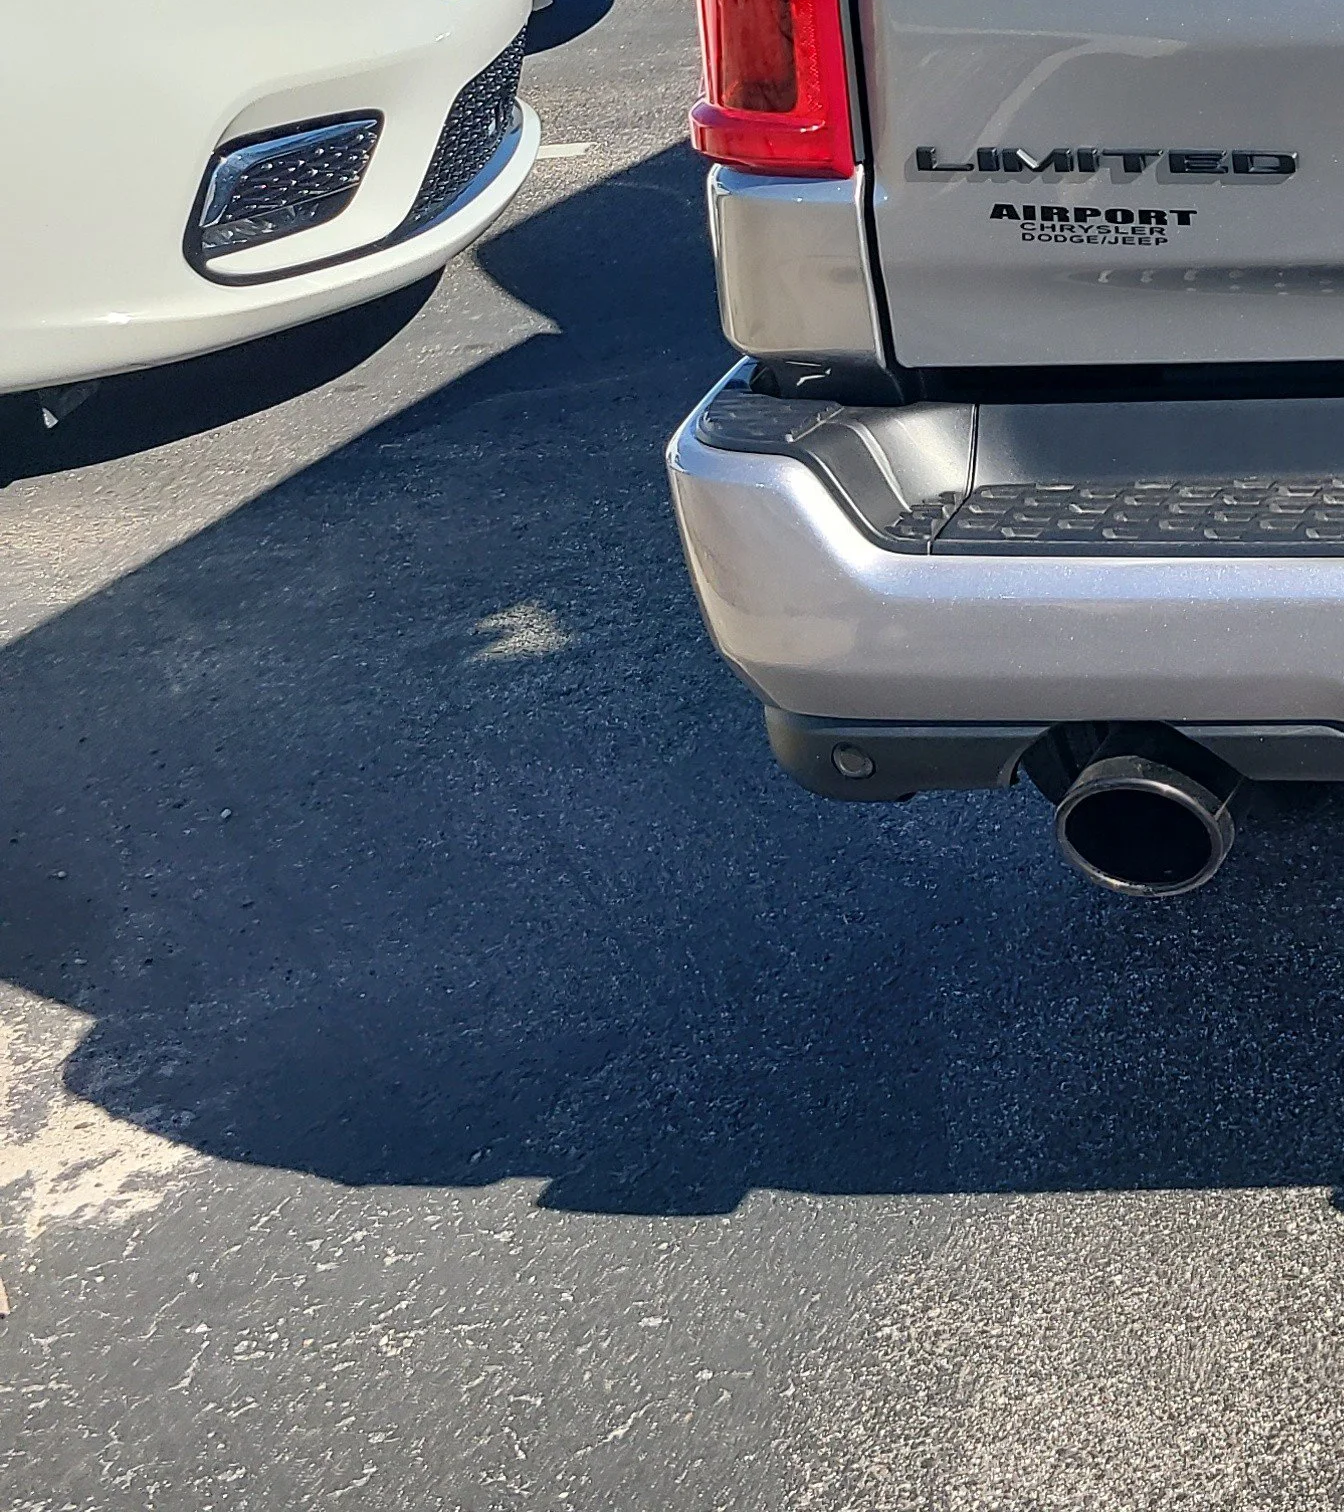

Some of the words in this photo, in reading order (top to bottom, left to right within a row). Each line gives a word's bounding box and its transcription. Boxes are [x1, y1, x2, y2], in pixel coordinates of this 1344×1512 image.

[915, 146, 1298, 174] LIMITED
[989, 203, 1198, 226] AIRPORT
[1019, 222, 1166, 236] CHRYSLER
[1021, 232, 1169, 246] DODGE/JEEP
